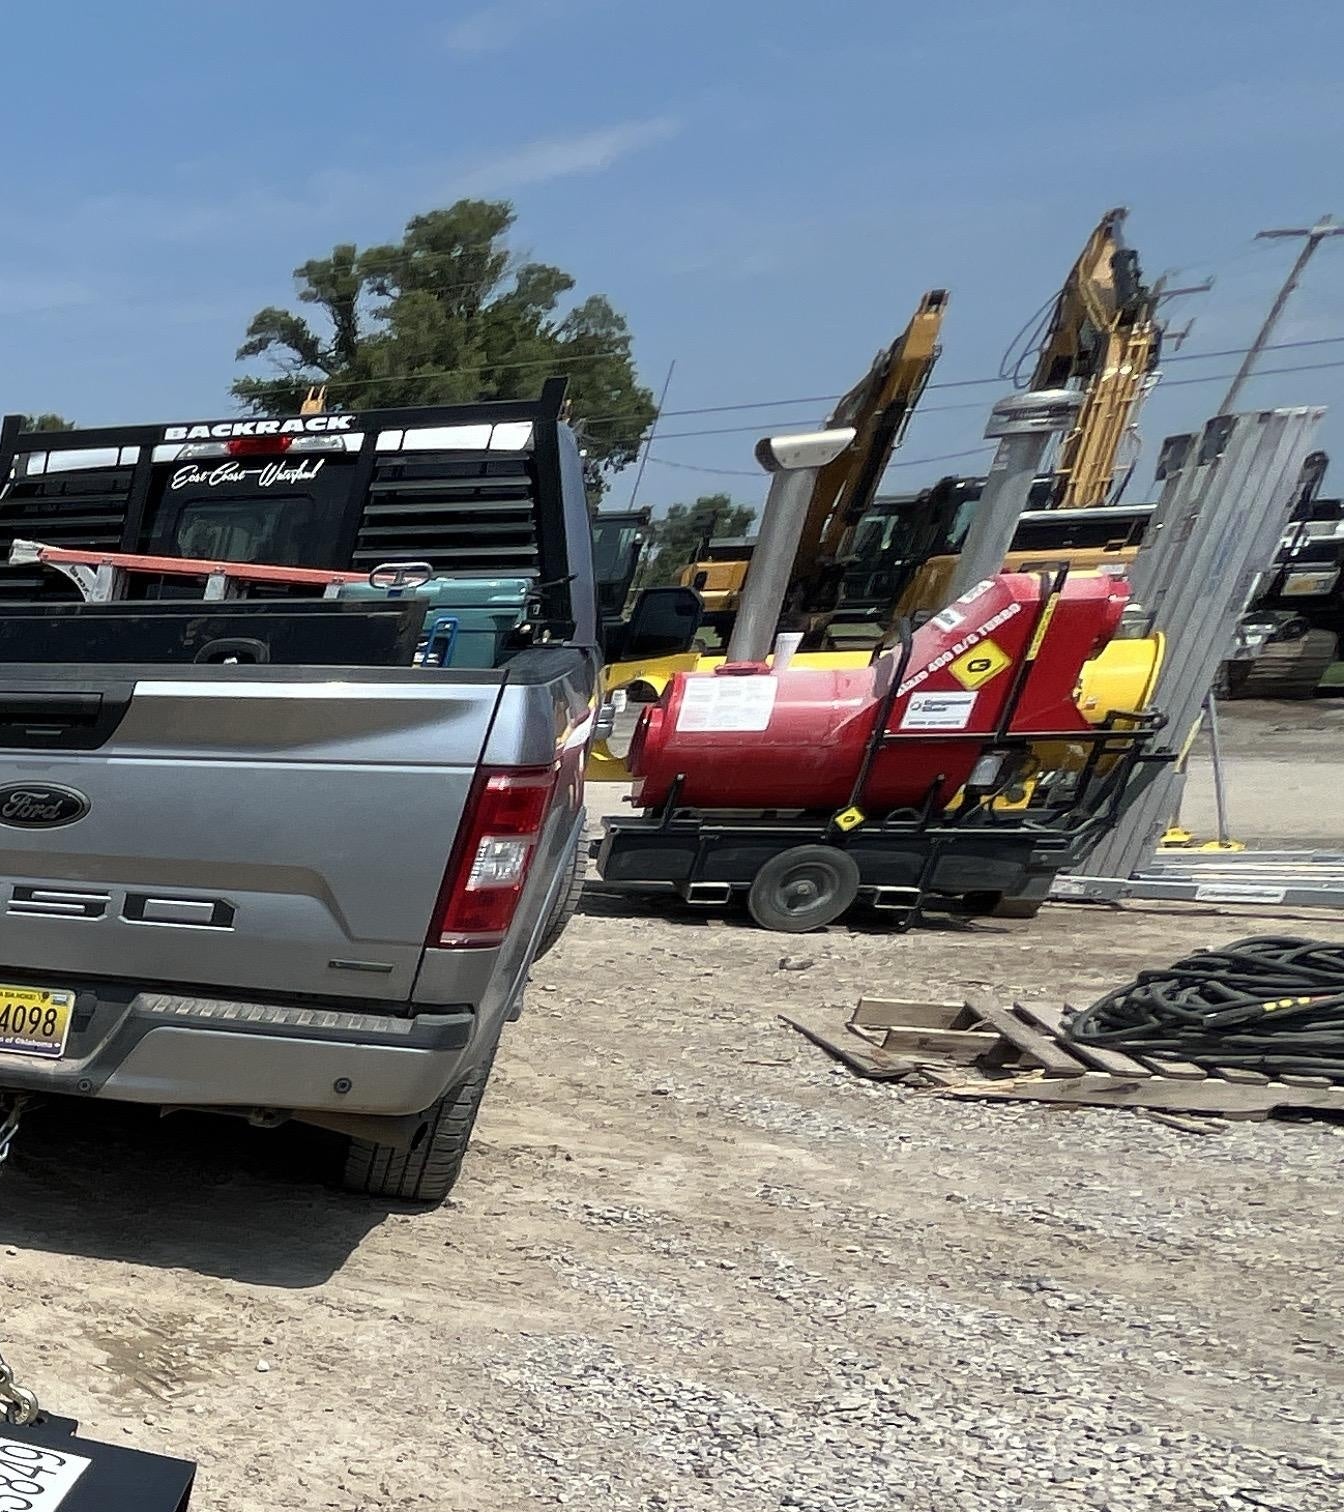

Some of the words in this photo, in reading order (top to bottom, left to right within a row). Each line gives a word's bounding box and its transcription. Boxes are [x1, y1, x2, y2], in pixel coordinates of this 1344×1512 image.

[164, 416, 352, 440] BACKRACK
[1, 790, 64, 819] Ford
[15, 1037, 53, 1048] Oklahoma
